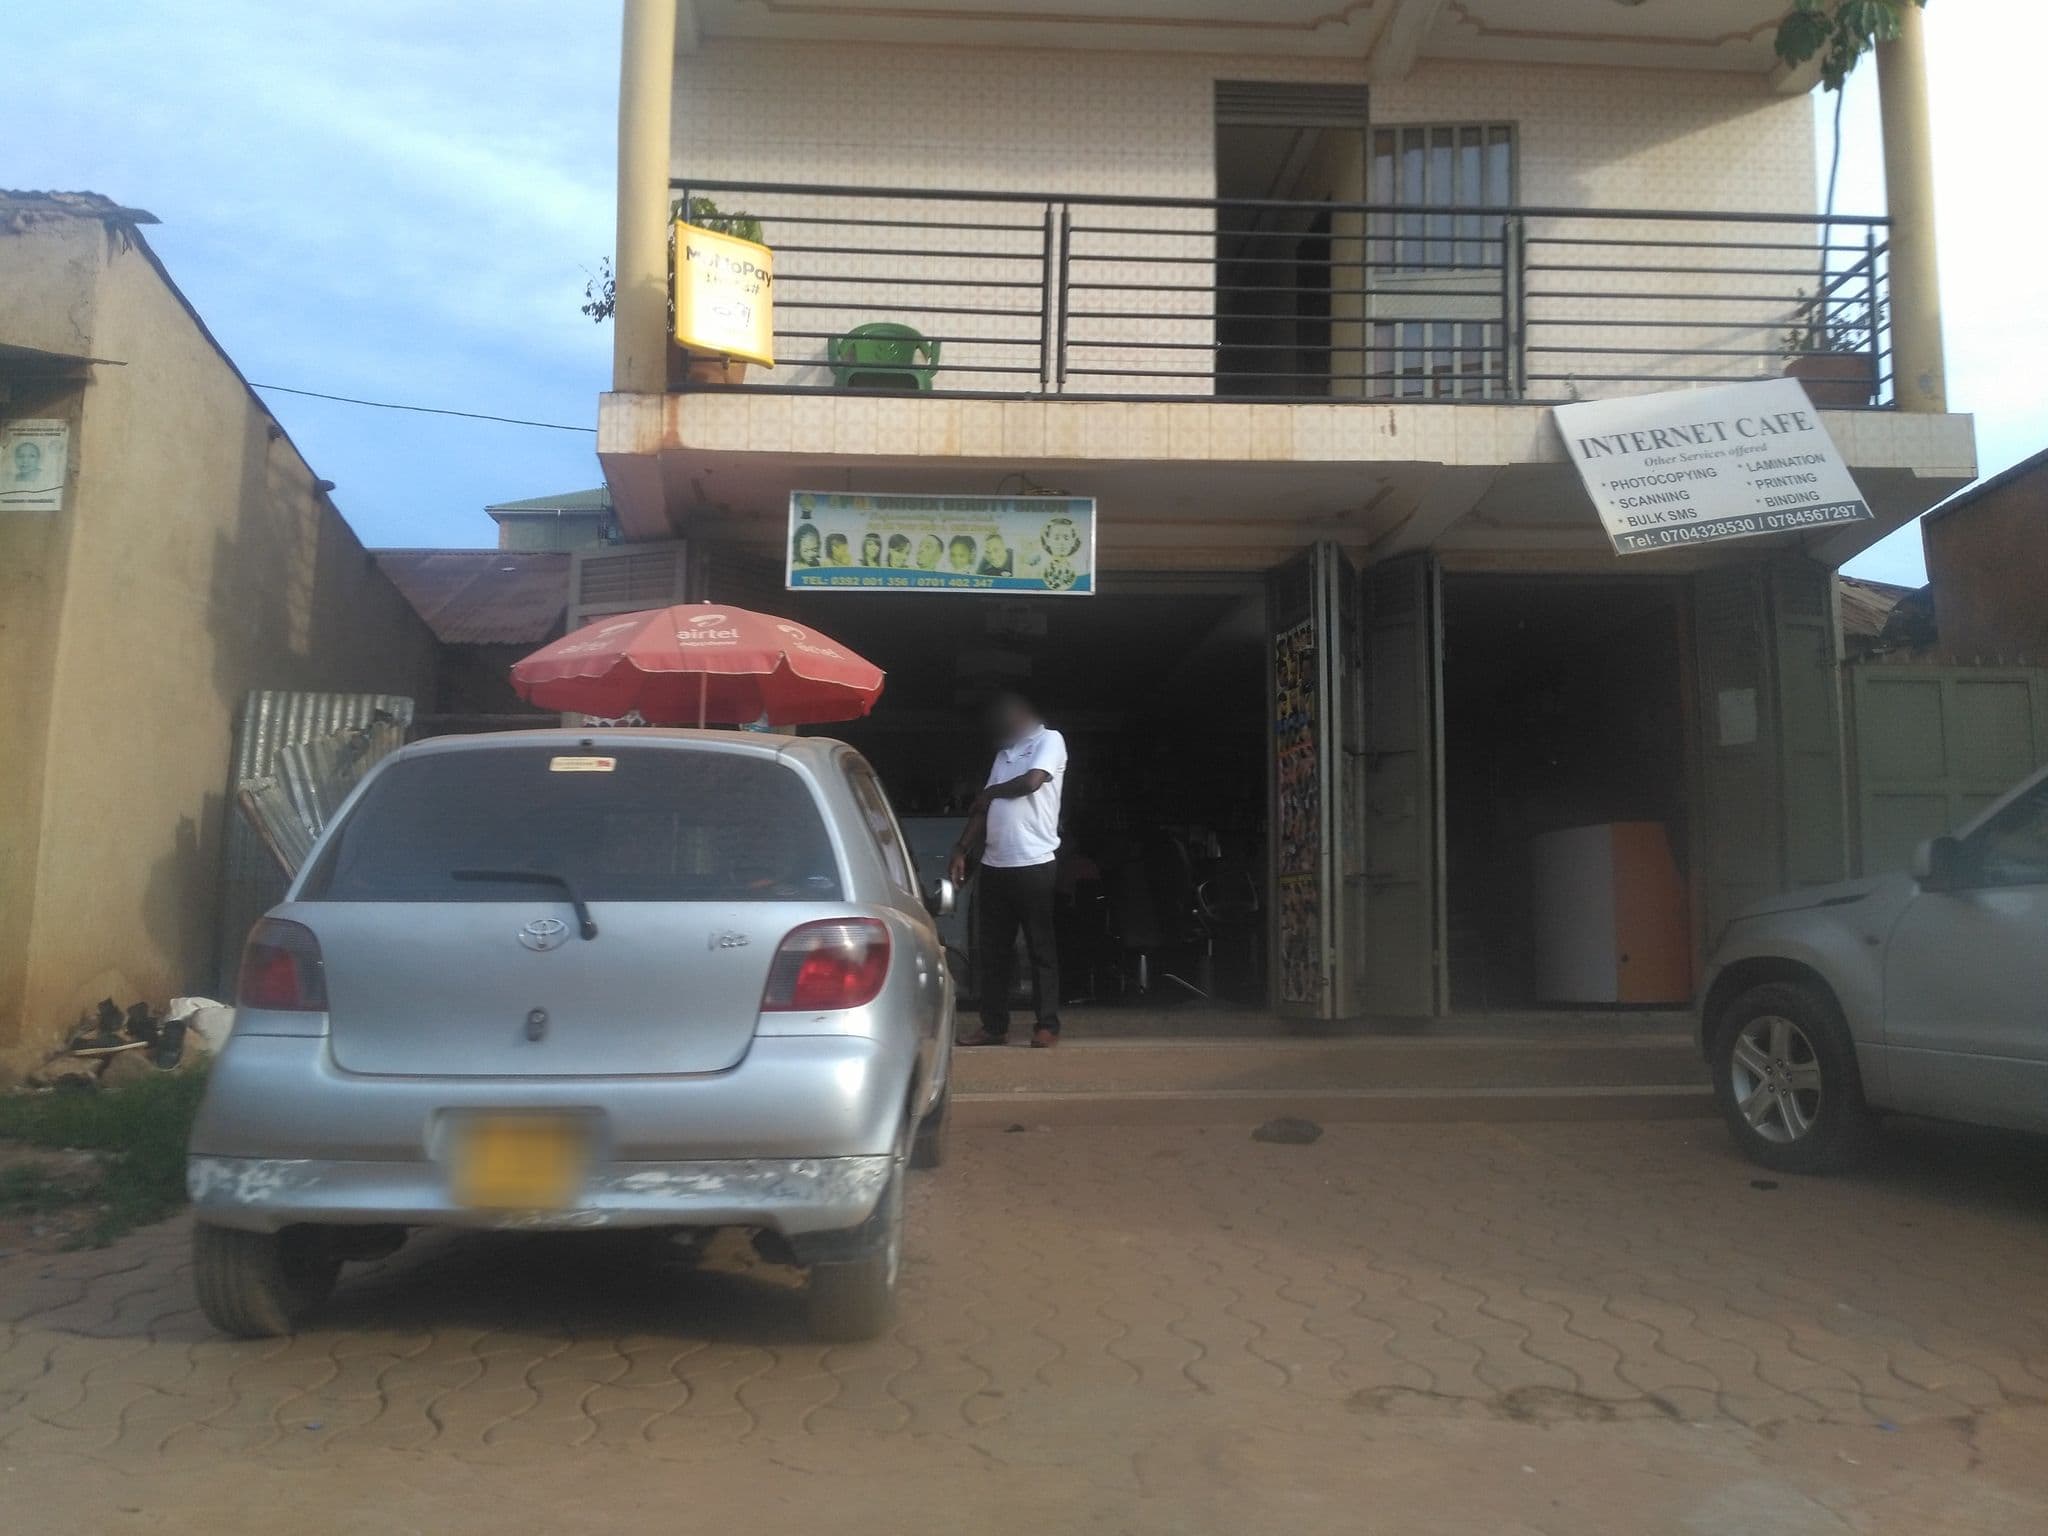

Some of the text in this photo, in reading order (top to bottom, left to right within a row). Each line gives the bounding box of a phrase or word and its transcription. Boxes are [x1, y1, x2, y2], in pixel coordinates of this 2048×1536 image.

[686, 245, 772, 288] MoPay
[1577, 411, 1814, 459] INTERNET CAFE
[1644, 443, 1768, 467] Other Services offered
[1746, 453, 1826, 472] LAMINATION
[1610, 467, 1718, 491] PHOTOCOPYING
[1755, 472, 1817, 490] PRINTING
[1619, 490, 1690, 509] SCANNING
[1765, 490, 1820, 508] BINDING
[1624, 534, 1658, 548] Tel:
[1660, 518, 1755, 543] 0704328530
[1767, 504, 1857, 528] 0784567297
[1627, 508, 1698, 527] BULK SMS
[676, 628, 741, 639] airtel
